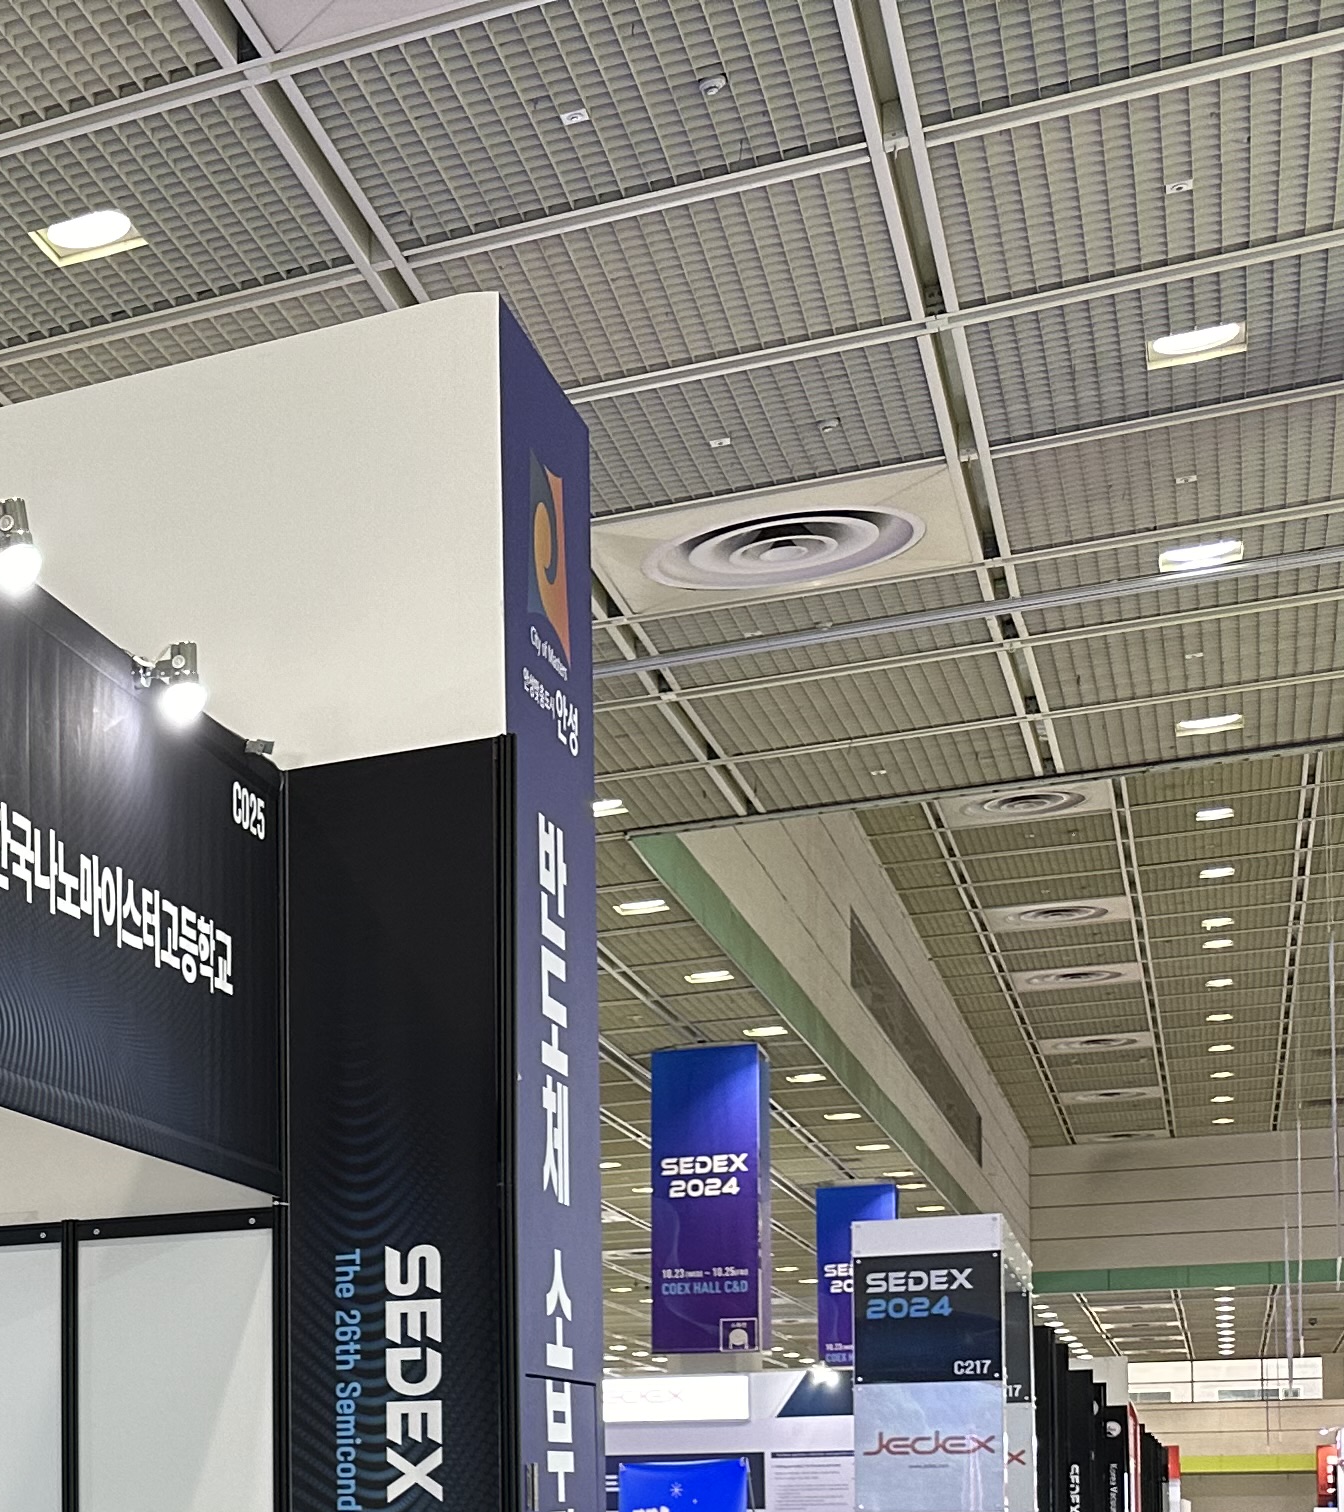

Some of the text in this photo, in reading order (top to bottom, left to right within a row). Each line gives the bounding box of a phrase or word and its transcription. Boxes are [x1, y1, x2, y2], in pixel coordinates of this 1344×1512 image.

[555, 689, 579, 757] 안성
[537, 811, 570, 1207] 반도체
[660, 1152, 749, 1177] SEDEX
[668, 1176, 741, 1199] 2024
[335, 1247, 361, 1299] The
[865, 1267, 974, 1294] SEDEX
[661, 1280, 749, 1296] COEX HALL C&D
[865, 1295, 954, 1320] 2024
[335, 1309, 361, 1371] 26th
[384, 1244, 444, 1503] SEDEX
[953, 1359, 992, 1376] C217
